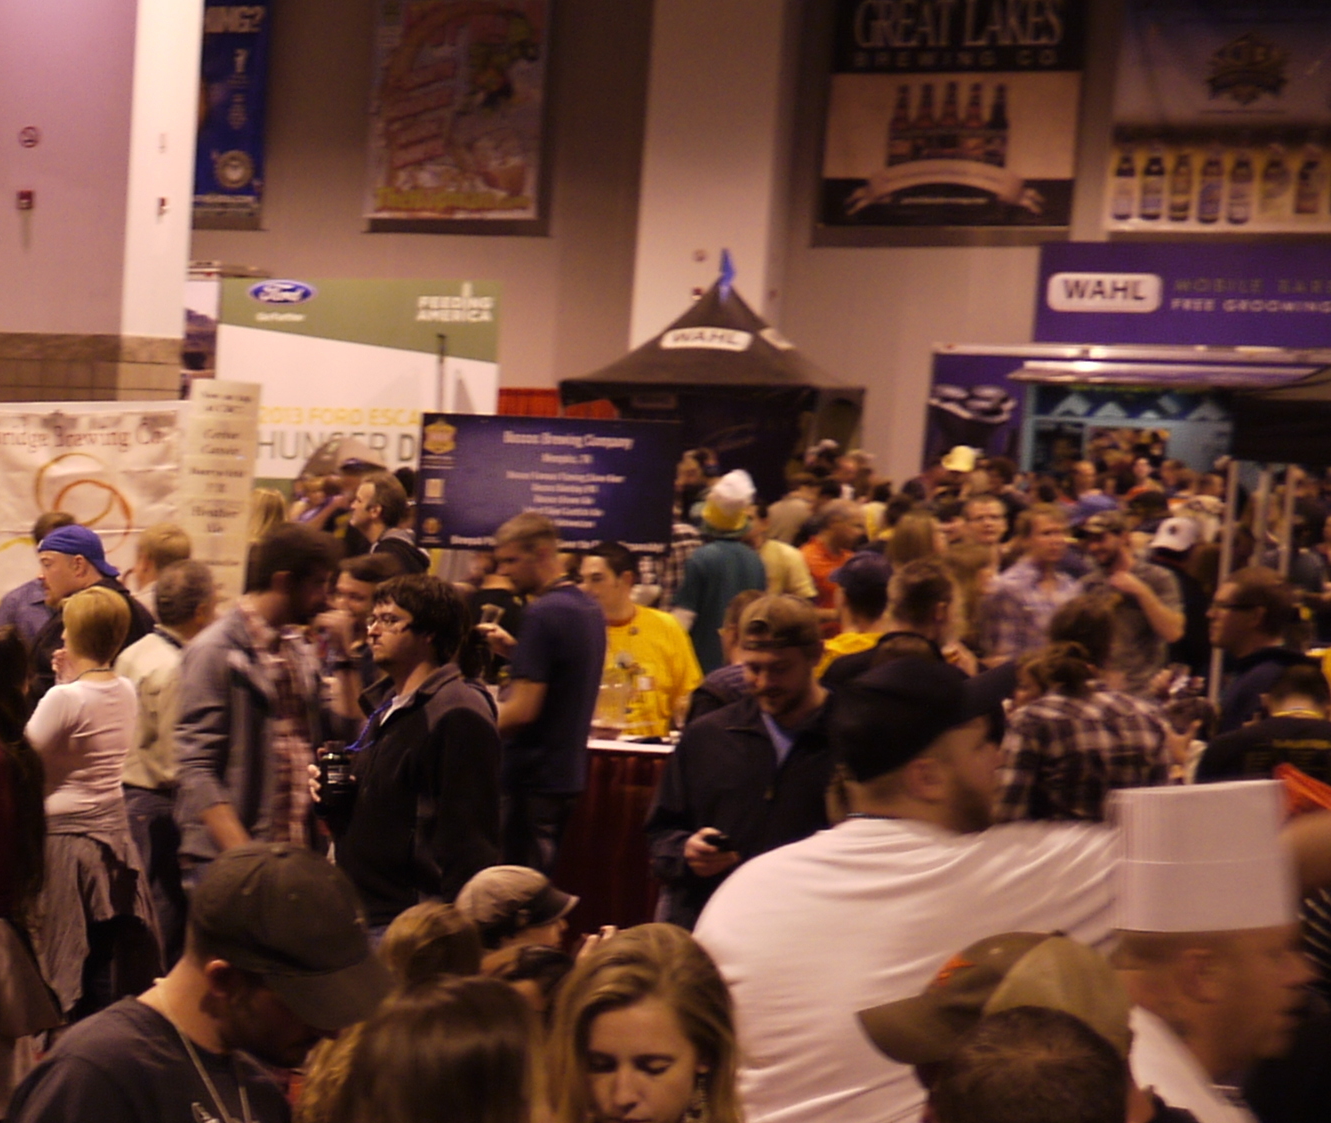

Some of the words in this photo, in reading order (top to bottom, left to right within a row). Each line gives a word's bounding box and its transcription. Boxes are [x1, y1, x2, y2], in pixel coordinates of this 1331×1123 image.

[853, 0, 951, 49] GREAT
[961, 0, 1064, 48] LAKES
[1063, 278, 1147, 301] WAHL
[1277, 278, 1331, 295] BAR
[416, 296, 494, 309] FEEDING
[1170, 298, 1217, 313] FREE
[1222, 298, 1331, 314] GROOMING
[415, 309, 493, 322] AMERICA
[672, 330, 741, 345] WAHL
[258, 406, 302, 426] 2013
[308, 406, 363, 426] FORD
[53, 422, 130, 453] Brewing
